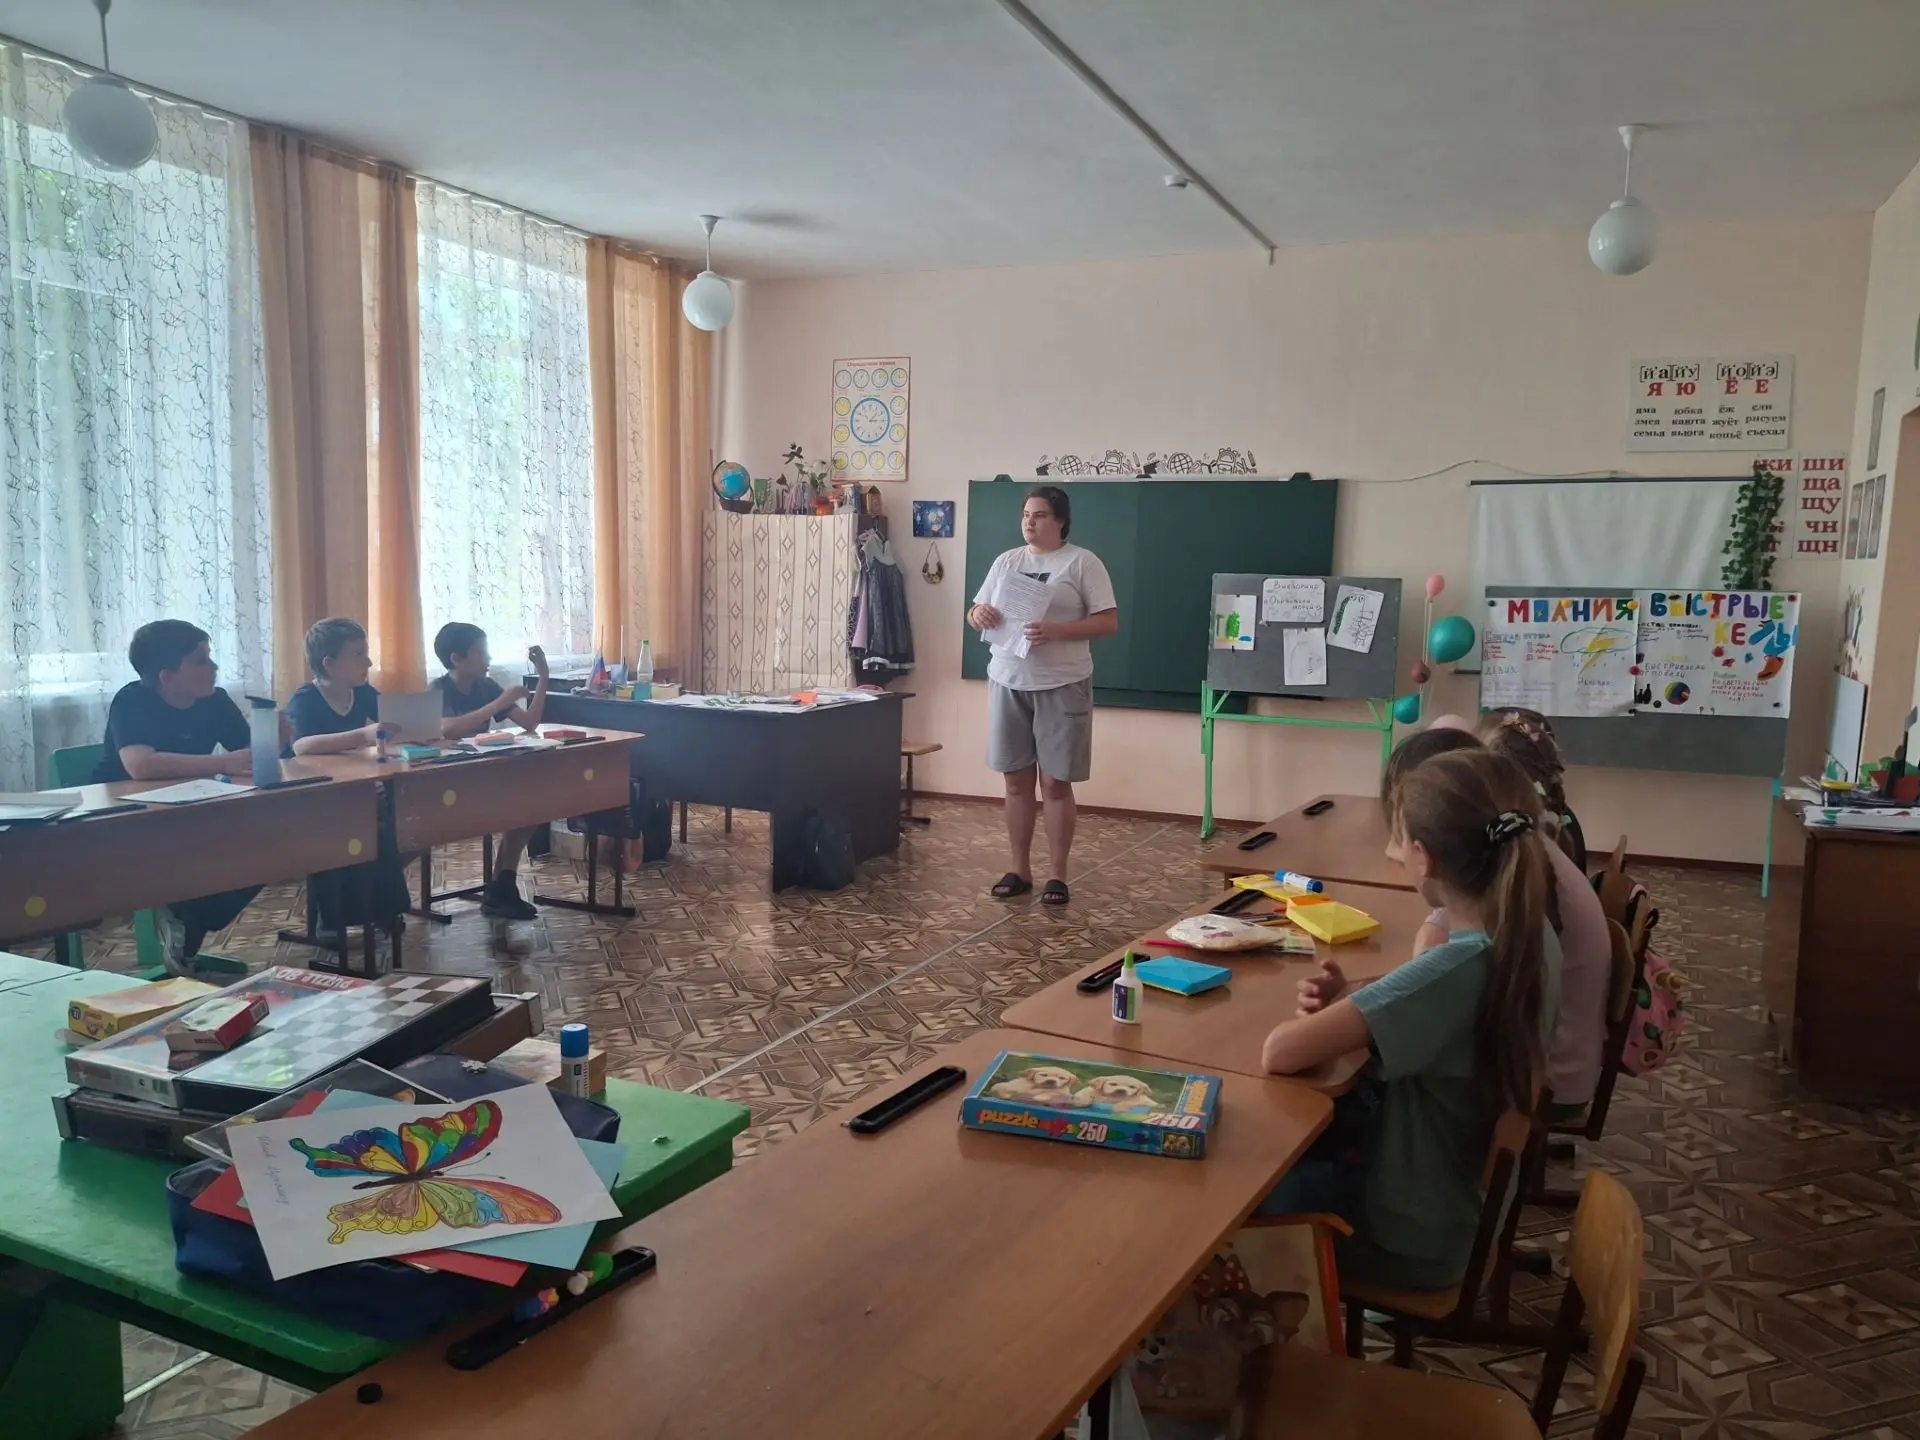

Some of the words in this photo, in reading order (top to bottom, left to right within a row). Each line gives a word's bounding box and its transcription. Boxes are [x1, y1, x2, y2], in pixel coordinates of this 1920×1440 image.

[1647, 382, 1663, 396] Я
[1676, 382, 1696, 396] Ю
[1725, 376, 1739, 395] Ё
[1755, 379, 1768, 394] Е
[1635, 407, 1657, 415] яма
[1674, 406, 1703, 415] юбка
[1671, 418, 1706, 426] каюта
[1745, 415, 1787, 425] рисуем
[1633, 430, 1665, 438] семья
[1670, 430, 1705, 438] вьюга
[1746, 429, 1785, 437] съехал
[1803, 459, 1845, 471] ши
[1803, 477, 1842, 493] ща
[1801, 497, 1841, 515] щу
[1805, 520, 1839, 534] чн
[1797, 540, 1840, 554] щн
[1507, 598, 1634, 624] МОЛНИЯ
[1650, 592, 1786, 620] БЫСТРЫЕ
[301, 974, 355, 989] PUZZLE
[978, 1108, 1041, 1129] puzzle
[1076, 1120, 1109, 1143] 250
[1141, 1111, 1200, 1130] 250
